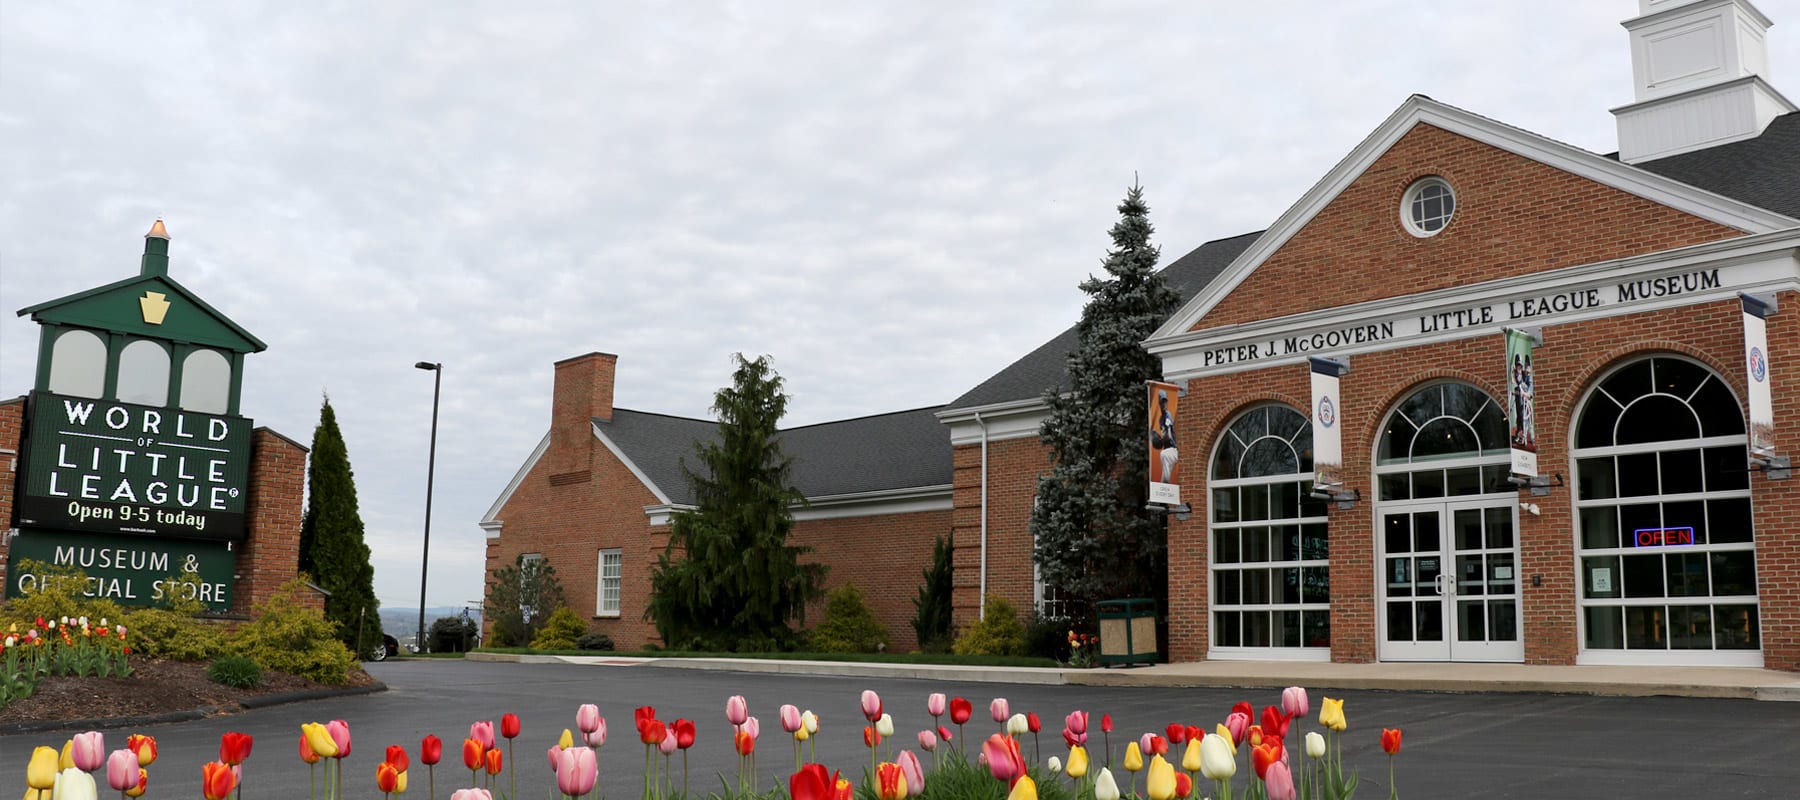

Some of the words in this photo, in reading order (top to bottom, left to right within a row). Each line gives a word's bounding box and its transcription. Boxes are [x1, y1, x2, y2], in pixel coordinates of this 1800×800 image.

[1204, 344, 1259, 367] PETER
[1265, 341, 1278, 357] J.
[1284, 321, 1394, 354] McGOVERN
[1420, 305, 1493, 334] LITTLE
[1508, 288, 1601, 320] LEAGUE
[1617, 268, 1721, 303] MUSEUM
[63, 399, 229, 442] WORLD
[137, 437, 154, 447] OF
[58, 443, 227, 484] LITTLE
[68, 501, 114, 523] Open
[119, 505, 150, 523] 9-5
[156, 509, 206, 531] today
[1637, 530, 1691, 546] OPEN
[54, 545, 168, 572] MUSEUM
[183, 553, 199, 573] &
[18, 573, 137, 599] OFCIAL
